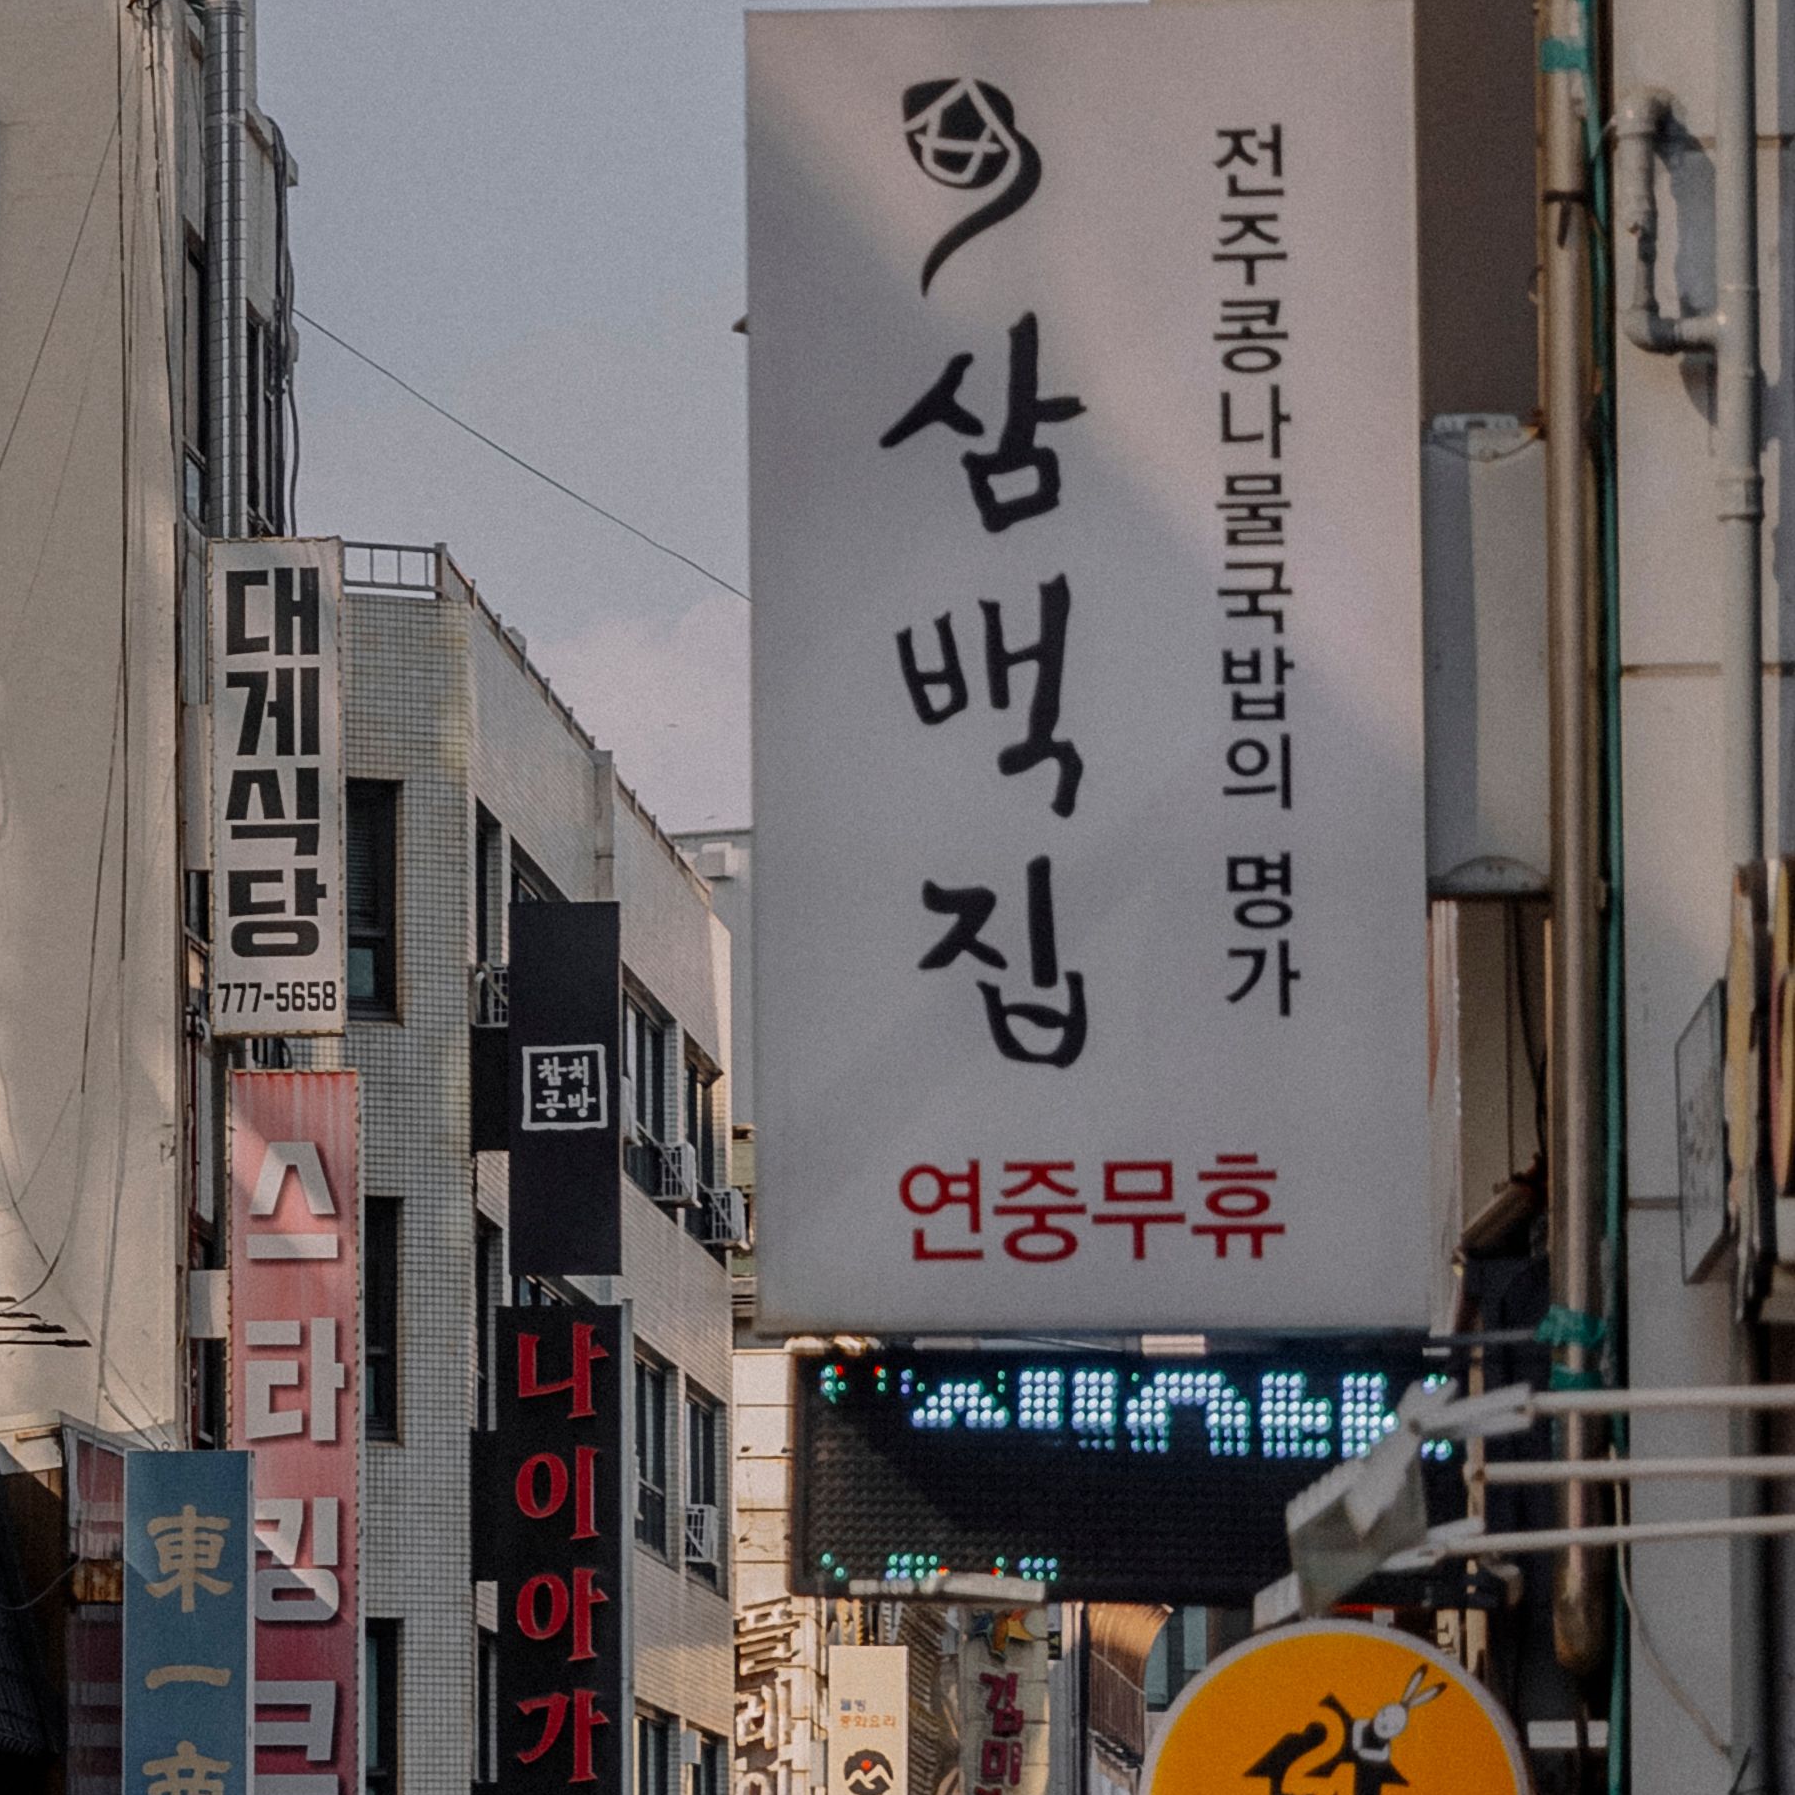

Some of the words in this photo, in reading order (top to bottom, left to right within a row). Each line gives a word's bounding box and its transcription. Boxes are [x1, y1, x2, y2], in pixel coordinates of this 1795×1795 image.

[1211, 122, 1296, 813] 전주콩나물국밥의
[879, 311, 1089, 1070] 삼백집
[225, 566, 328, 959] 대게식당
[216, 980, 338, 1014] 777-5658
[1225, 849, 1301, 1018] 명가
[535, 1088, 597, 1119] 공방
[537, 1055, 590, 1087] 참치
[898, 1152, 1288, 1266] 연중무휴
